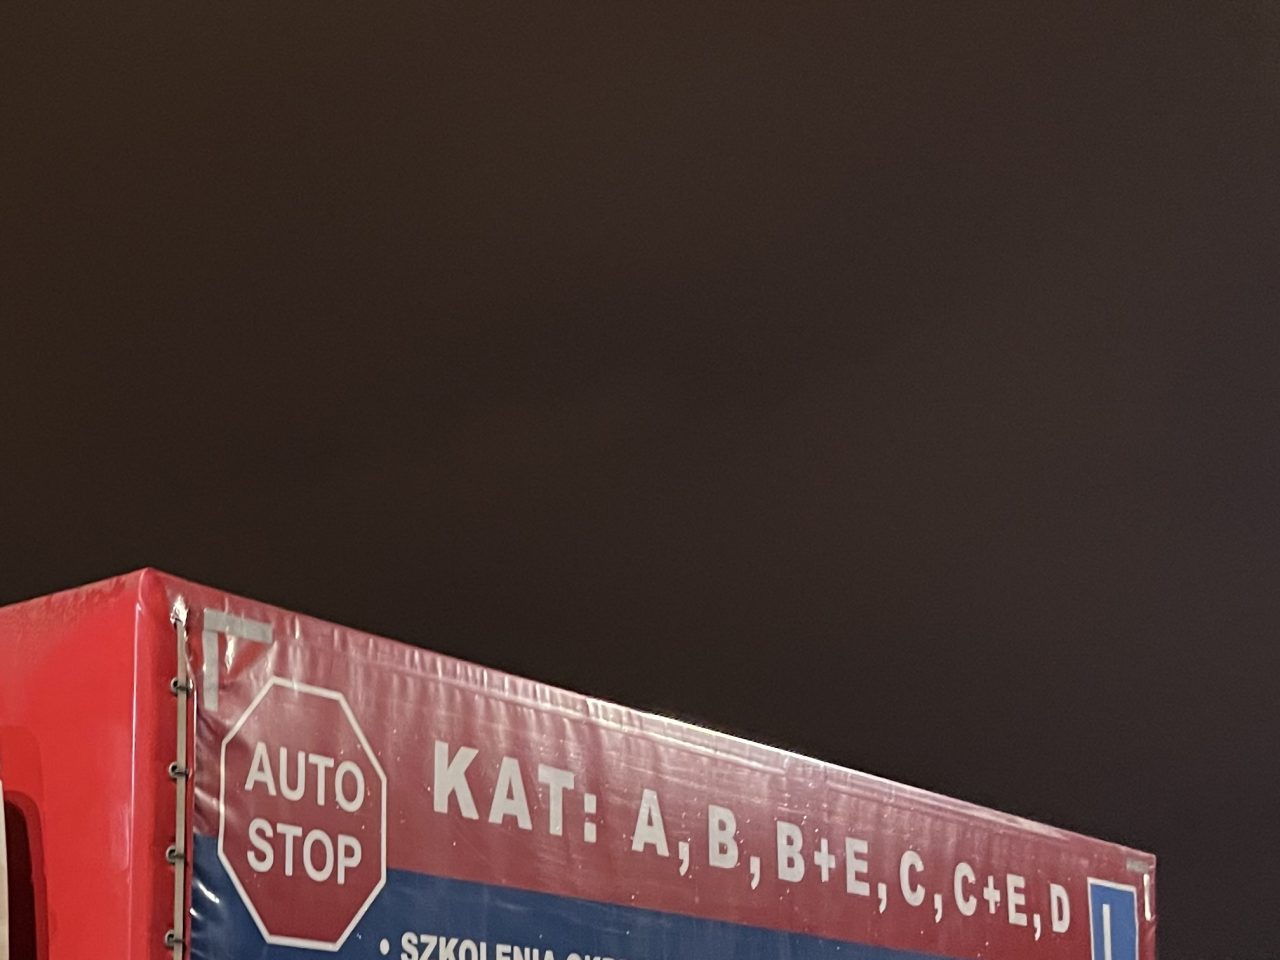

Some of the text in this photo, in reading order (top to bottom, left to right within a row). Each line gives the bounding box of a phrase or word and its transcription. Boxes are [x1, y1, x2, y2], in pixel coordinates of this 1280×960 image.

[245, 742, 366, 814] AUTO
[247, 818, 363, 885] STOP
[432, 740, 1071, 941] KAT: A, B, B+E, C, C+E, D
